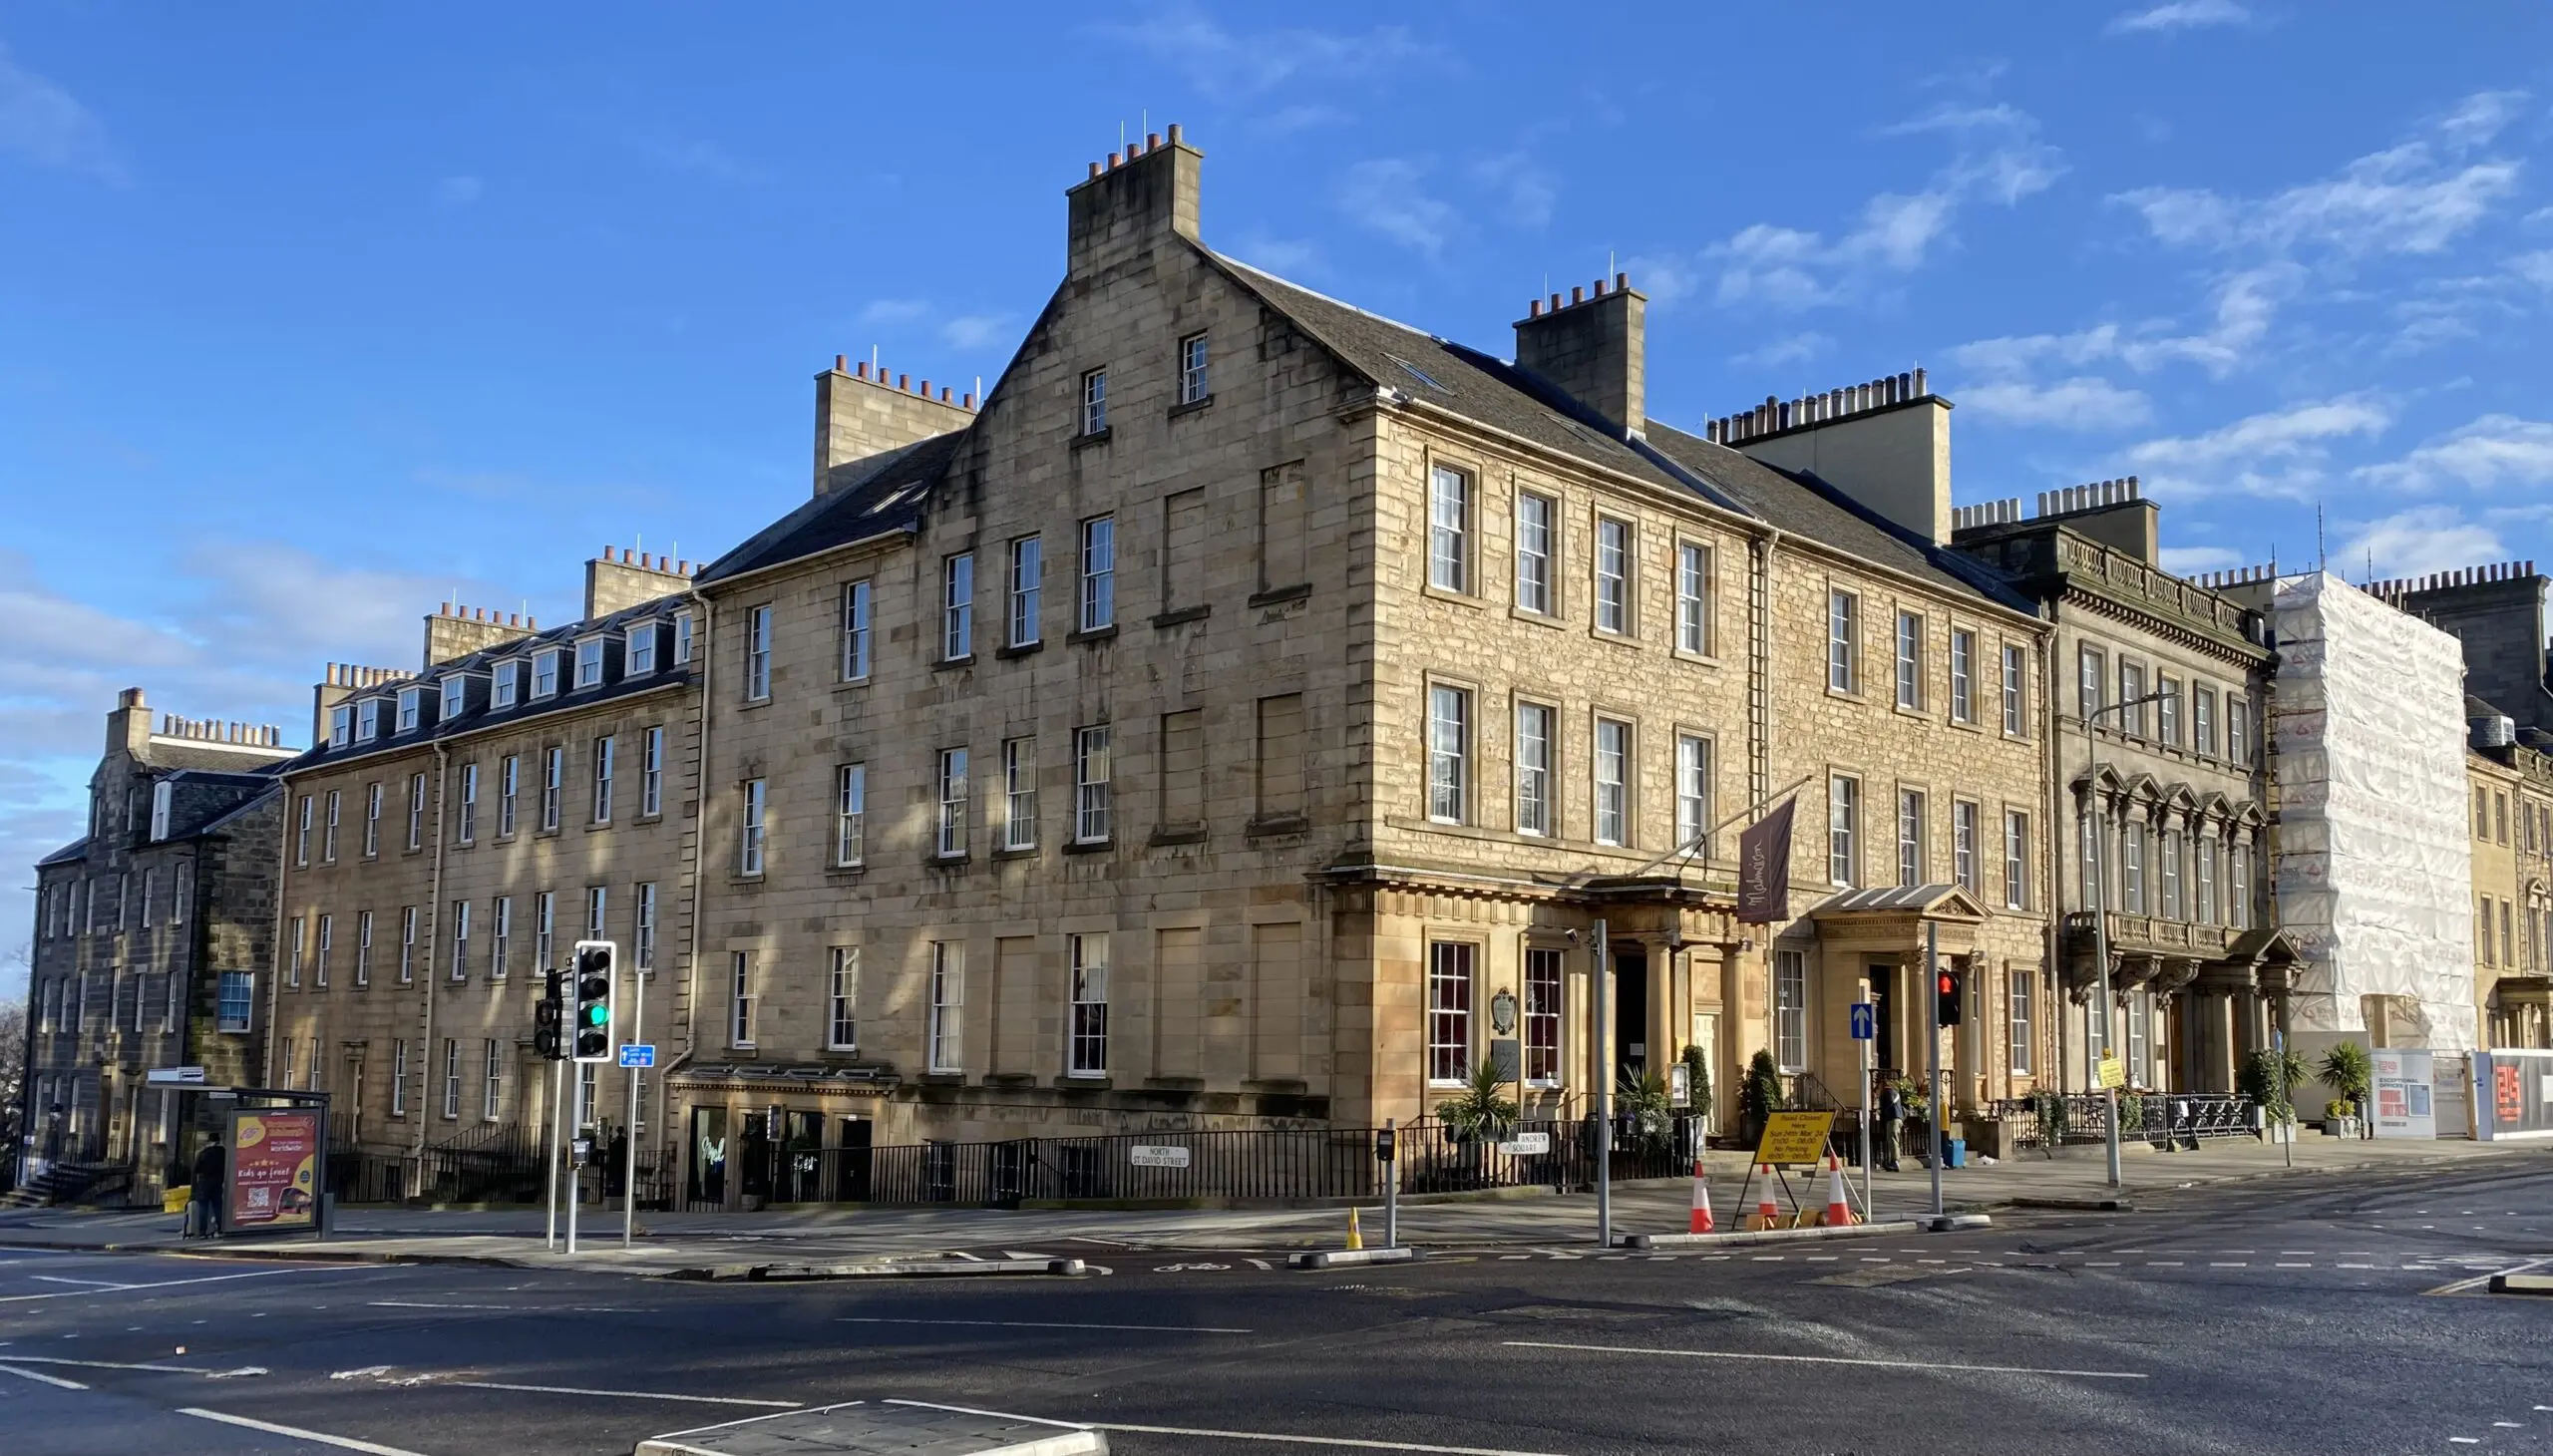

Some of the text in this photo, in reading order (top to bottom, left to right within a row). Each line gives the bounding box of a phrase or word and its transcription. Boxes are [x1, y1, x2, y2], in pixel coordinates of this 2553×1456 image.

[1745, 839, 1767, 906] Malmaison
[1133, 1156, 1140, 1165] ST
[1163, 1157, 1187, 1166] STREET
[257, 1171, 266, 1180] go
